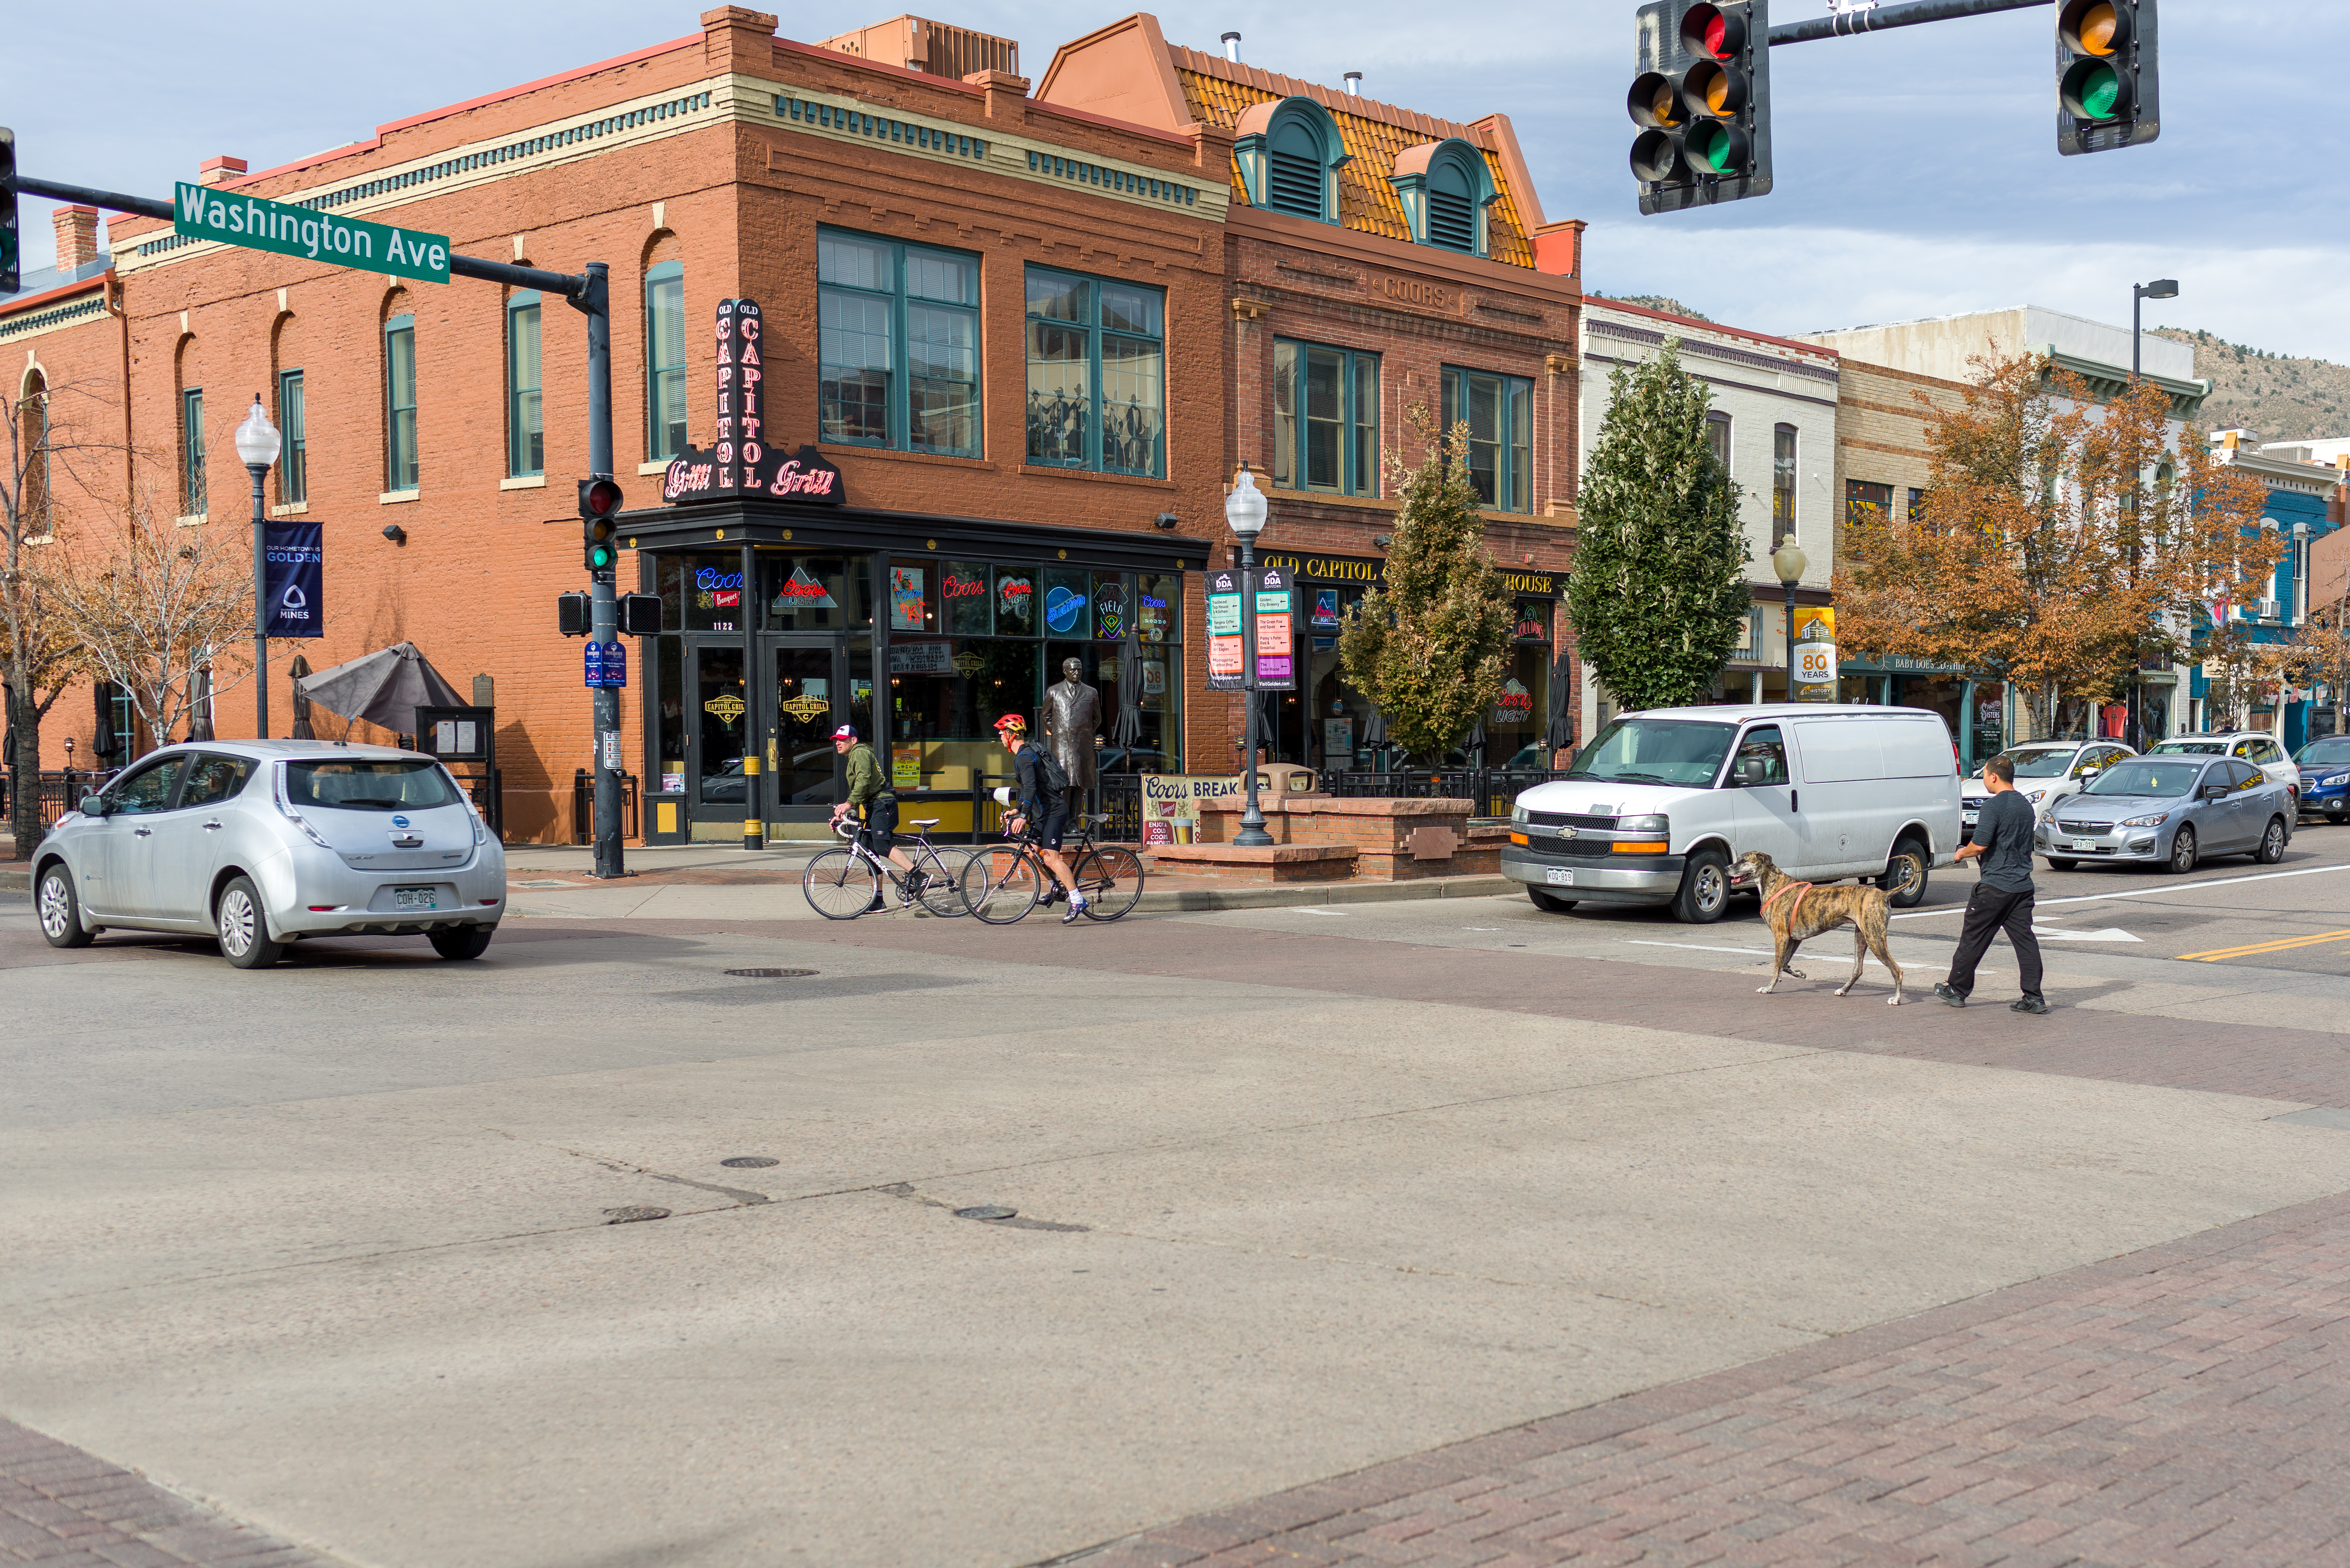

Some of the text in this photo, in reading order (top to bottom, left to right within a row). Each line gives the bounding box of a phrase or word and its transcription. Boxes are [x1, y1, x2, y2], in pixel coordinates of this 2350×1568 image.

[181, 185, 446, 271] Washington Ave
[1384, 276, 1444, 308] COORS
[719, 305, 732, 315] OLD
[740, 305, 758, 315] OLD
[716, 317, 733, 489] CAPITOL
[741, 317, 762, 489] CAPITOL
[665, 460, 712, 498] Grill
[770, 460, 835, 495] Grill
[267, 552, 321, 563] GOLDEN
[1306, 559, 1377, 581] CAPITOL
[696, 568, 743, 589] Coor
[1502, 574, 1552, 593] HOUSE
[781, 579, 827, 597] Coors
[942, 576, 985, 598] Coors
[1003, 582, 1031, 598] Coors
[716, 592, 737, 605] Banquet
[789, 597, 819, 605] LIGHT
[896, 589, 923, 603] Coors
[1007, 594, 1030, 608] LIGHT
[1066, 596, 1085, 612] MOON
[1143, 595, 1166, 608] Coors
[1100, 600, 1123, 615] FIELD
[1315, 605, 1335, 617] Coors
[1803, 654, 1827, 671] 80
[1895, 658, 1965, 670] BABY DOE'S LOTHIN
[1495, 710, 1530, 722] LIGHT
[1145, 776, 1188, 799] Coors
[1160, 803, 1175, 815] Banquet
[868, 849, 890, 874] TREK
[1033, 851, 1045, 865] SURLY
